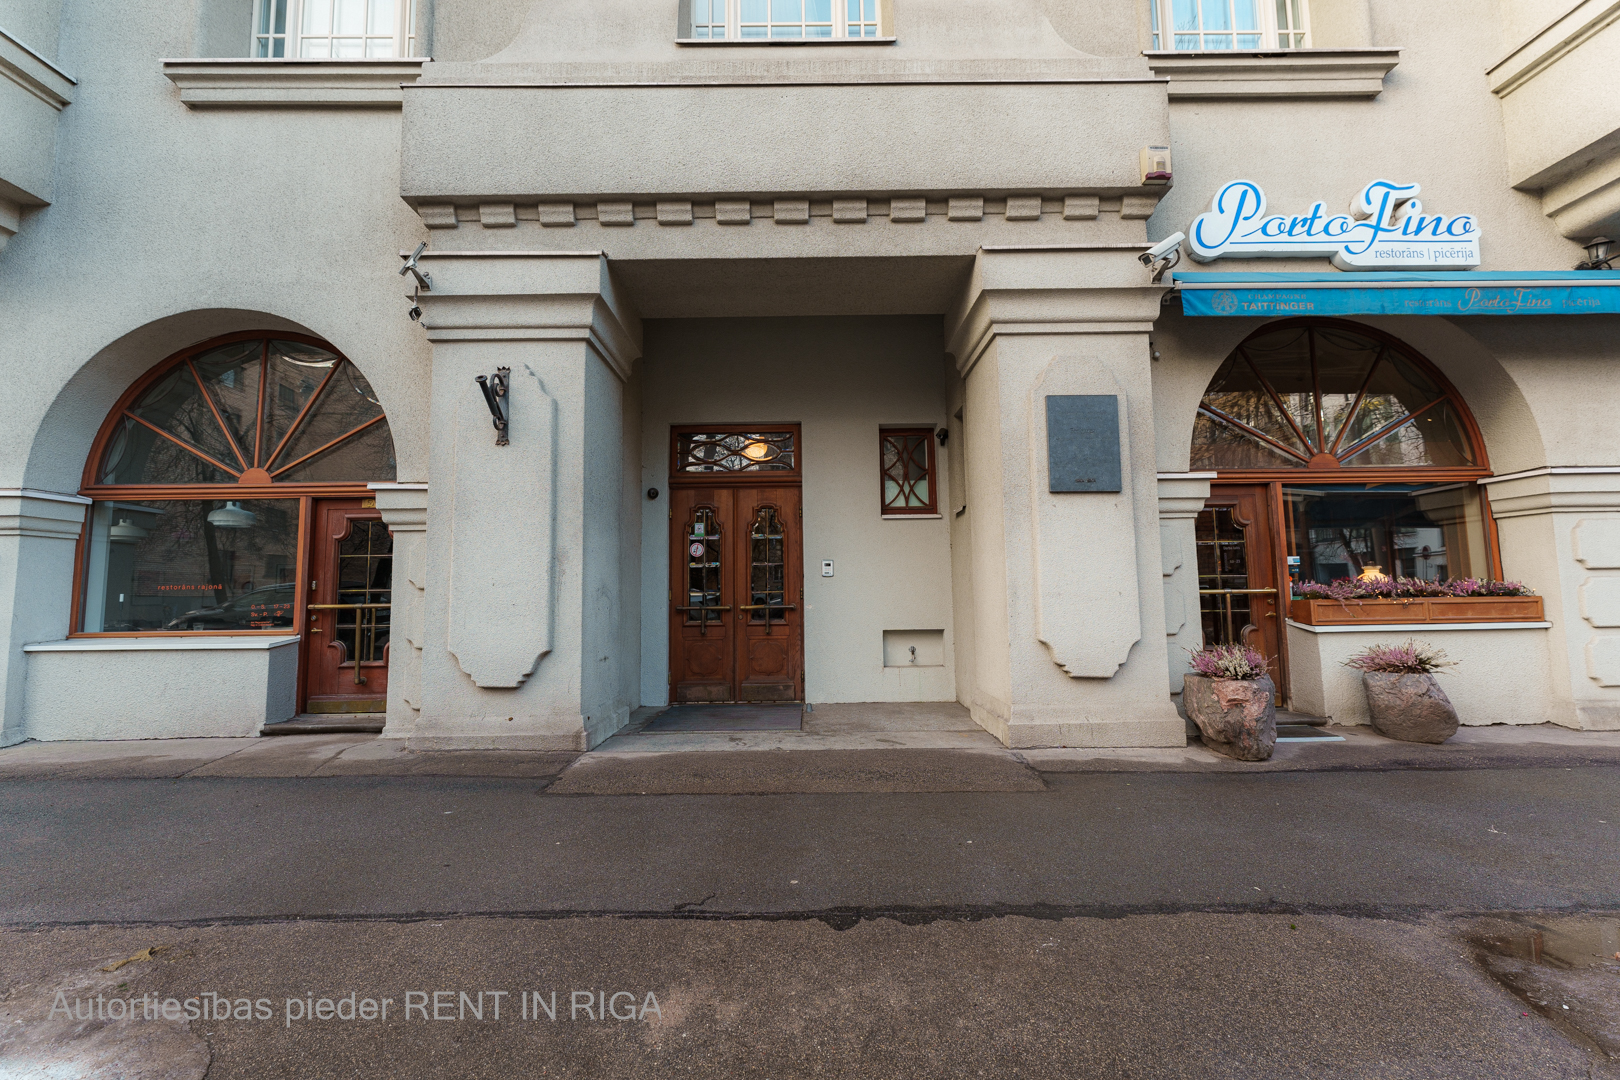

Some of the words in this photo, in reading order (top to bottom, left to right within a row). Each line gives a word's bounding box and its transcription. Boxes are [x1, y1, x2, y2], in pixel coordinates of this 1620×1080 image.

[1374, 247, 1425, 260] restorāns
[1433, 247, 1474, 263] picērija
[1241, 302, 1315, 310] TAITTINGER
[1562, 298, 1601, 309] picērija
[197, 583, 223, 591] rajonā
